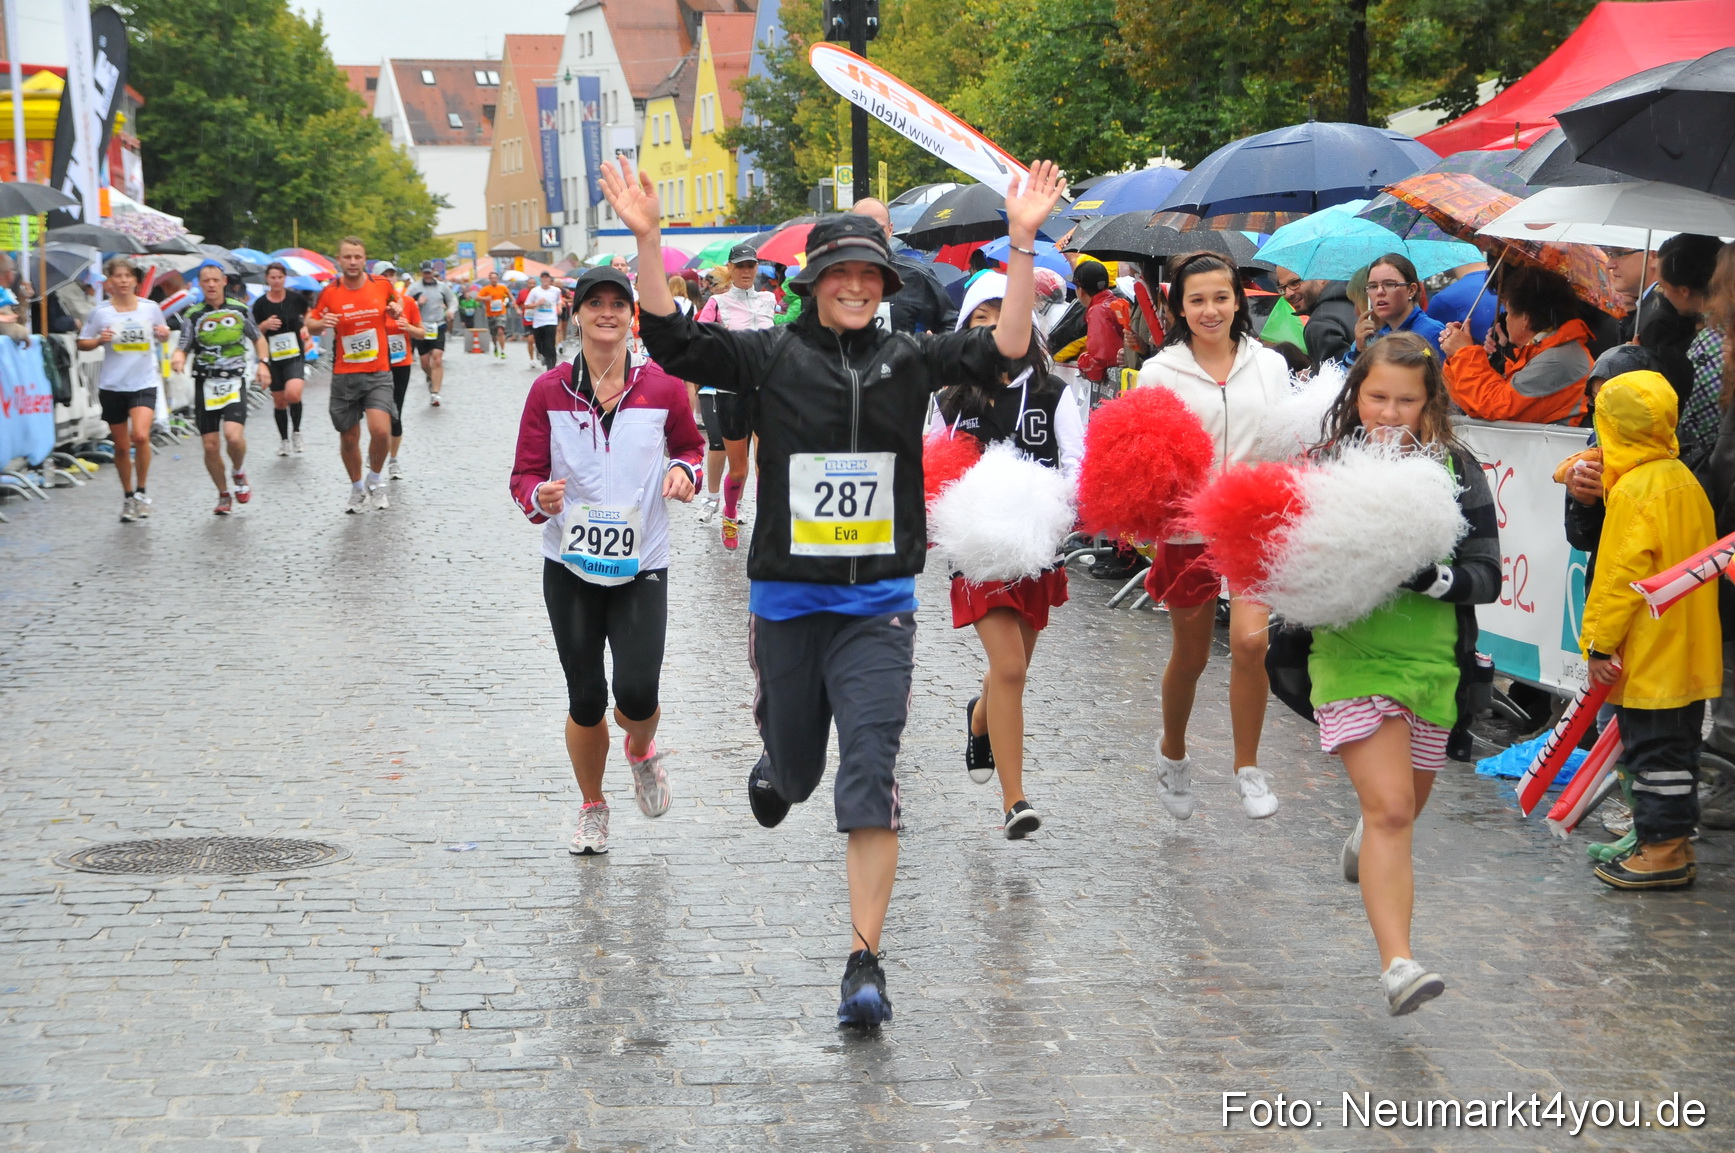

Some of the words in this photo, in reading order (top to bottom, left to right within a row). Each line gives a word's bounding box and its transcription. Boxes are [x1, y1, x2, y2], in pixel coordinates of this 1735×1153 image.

[120, 330, 145, 343] 394
[1022, 409, 1047, 445] C
[814, 481, 878, 517] 287
[568, 525, 635, 556] 2929
[834, 527, 858, 540] Eva
[582, 559, 620, 575] Kathrin
